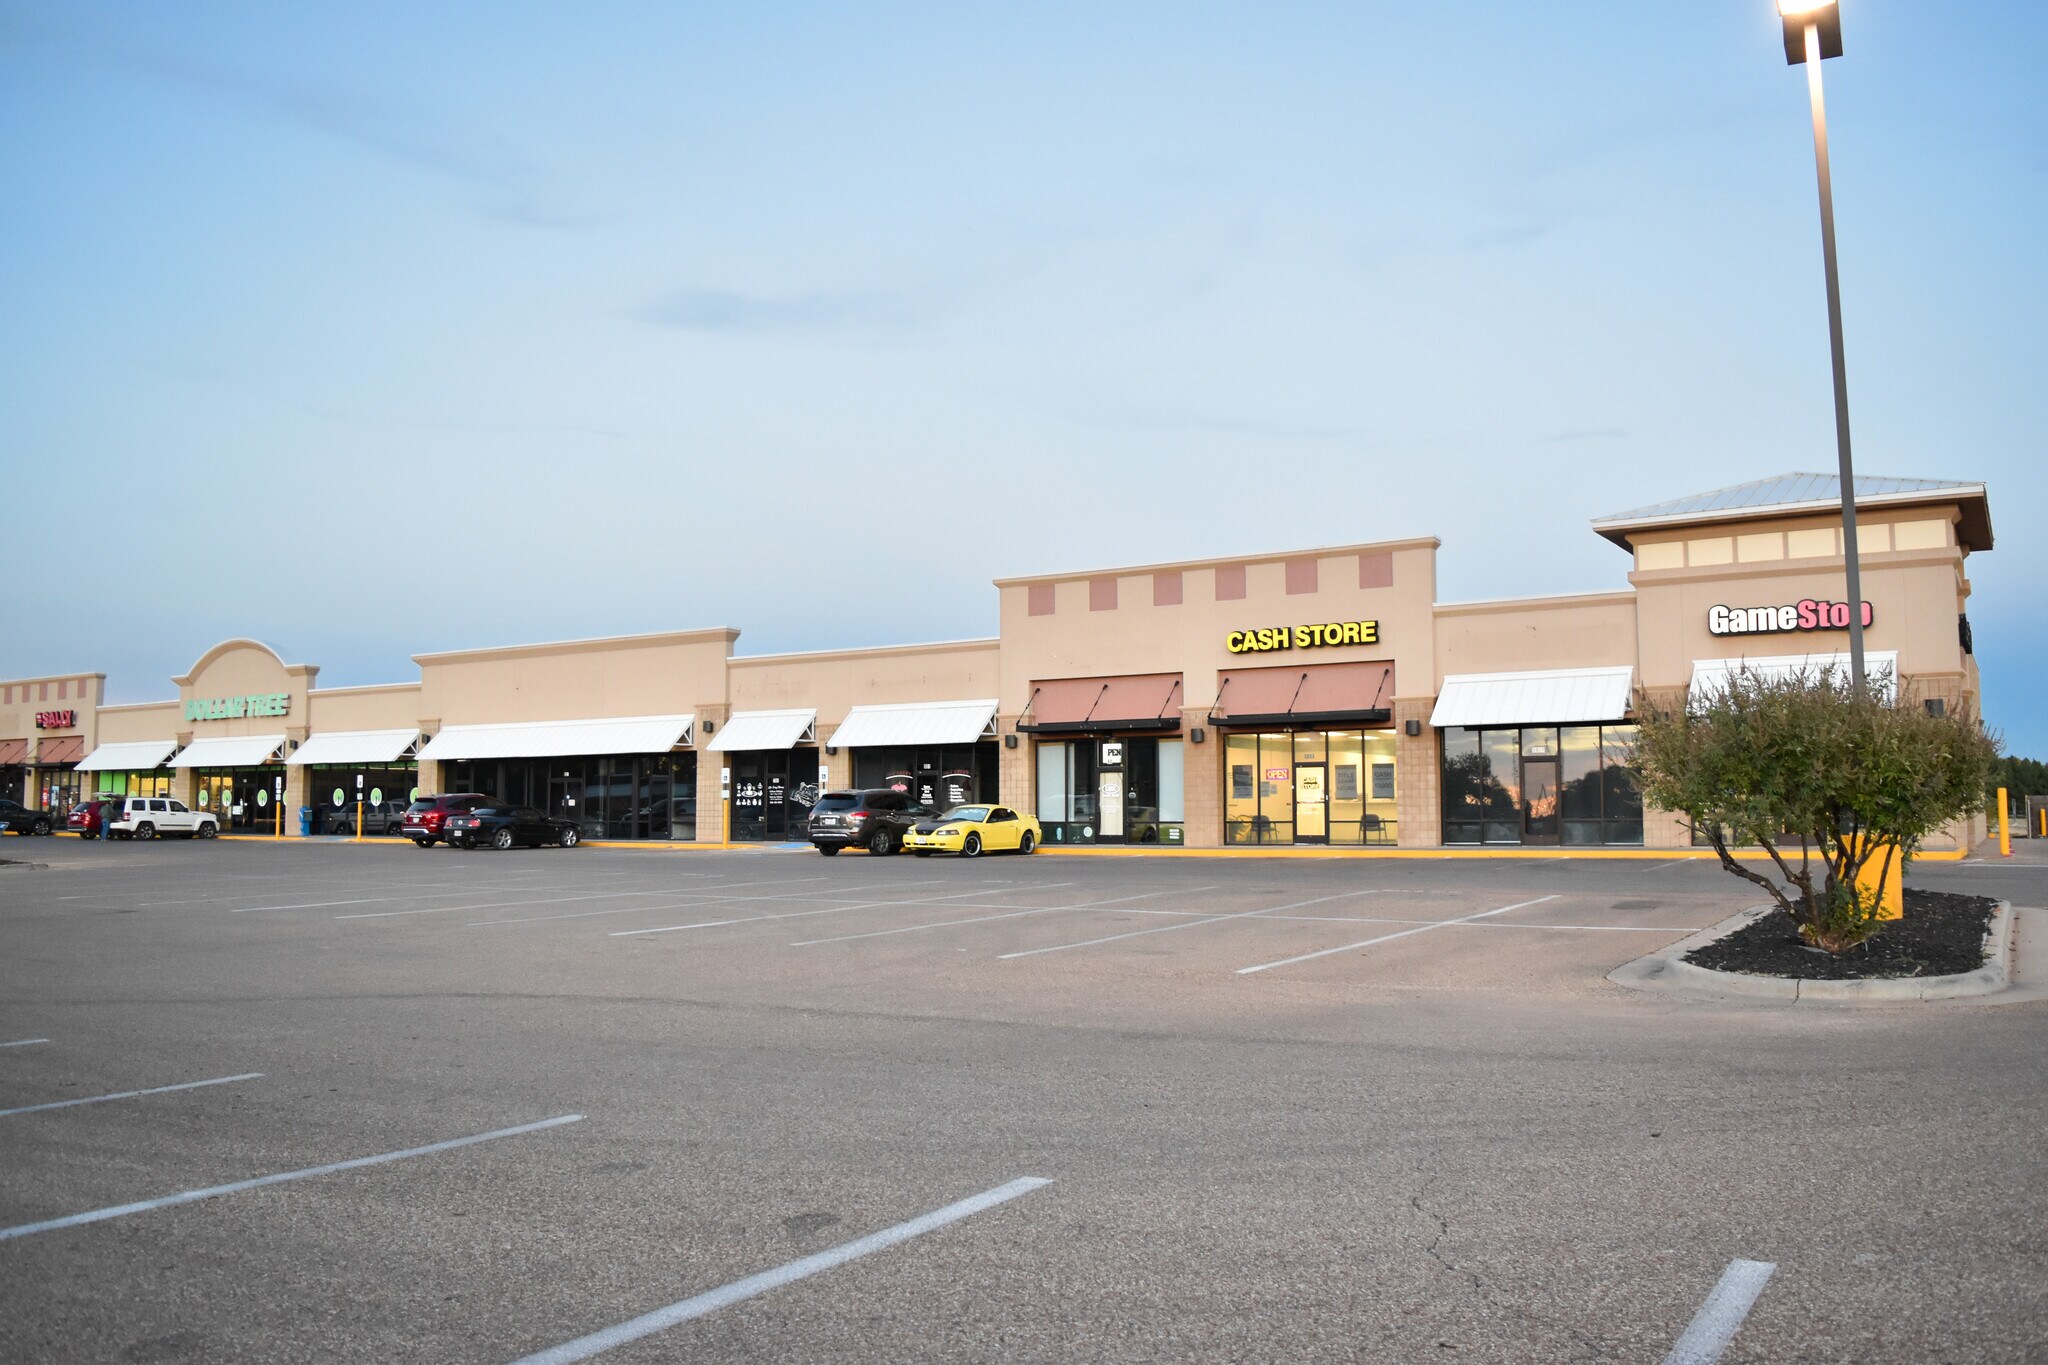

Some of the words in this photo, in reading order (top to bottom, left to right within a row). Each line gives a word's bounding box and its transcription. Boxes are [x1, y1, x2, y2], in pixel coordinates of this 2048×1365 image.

[1226, 627, 1289, 653] CASH
[1295, 621, 1377, 648] STORE
[185, 697, 245, 721] DOLLAR
[246, 693, 289, 717] TREE
[42, 710, 72, 728] SALLY
[1267, 770, 1288, 780] OPEN
